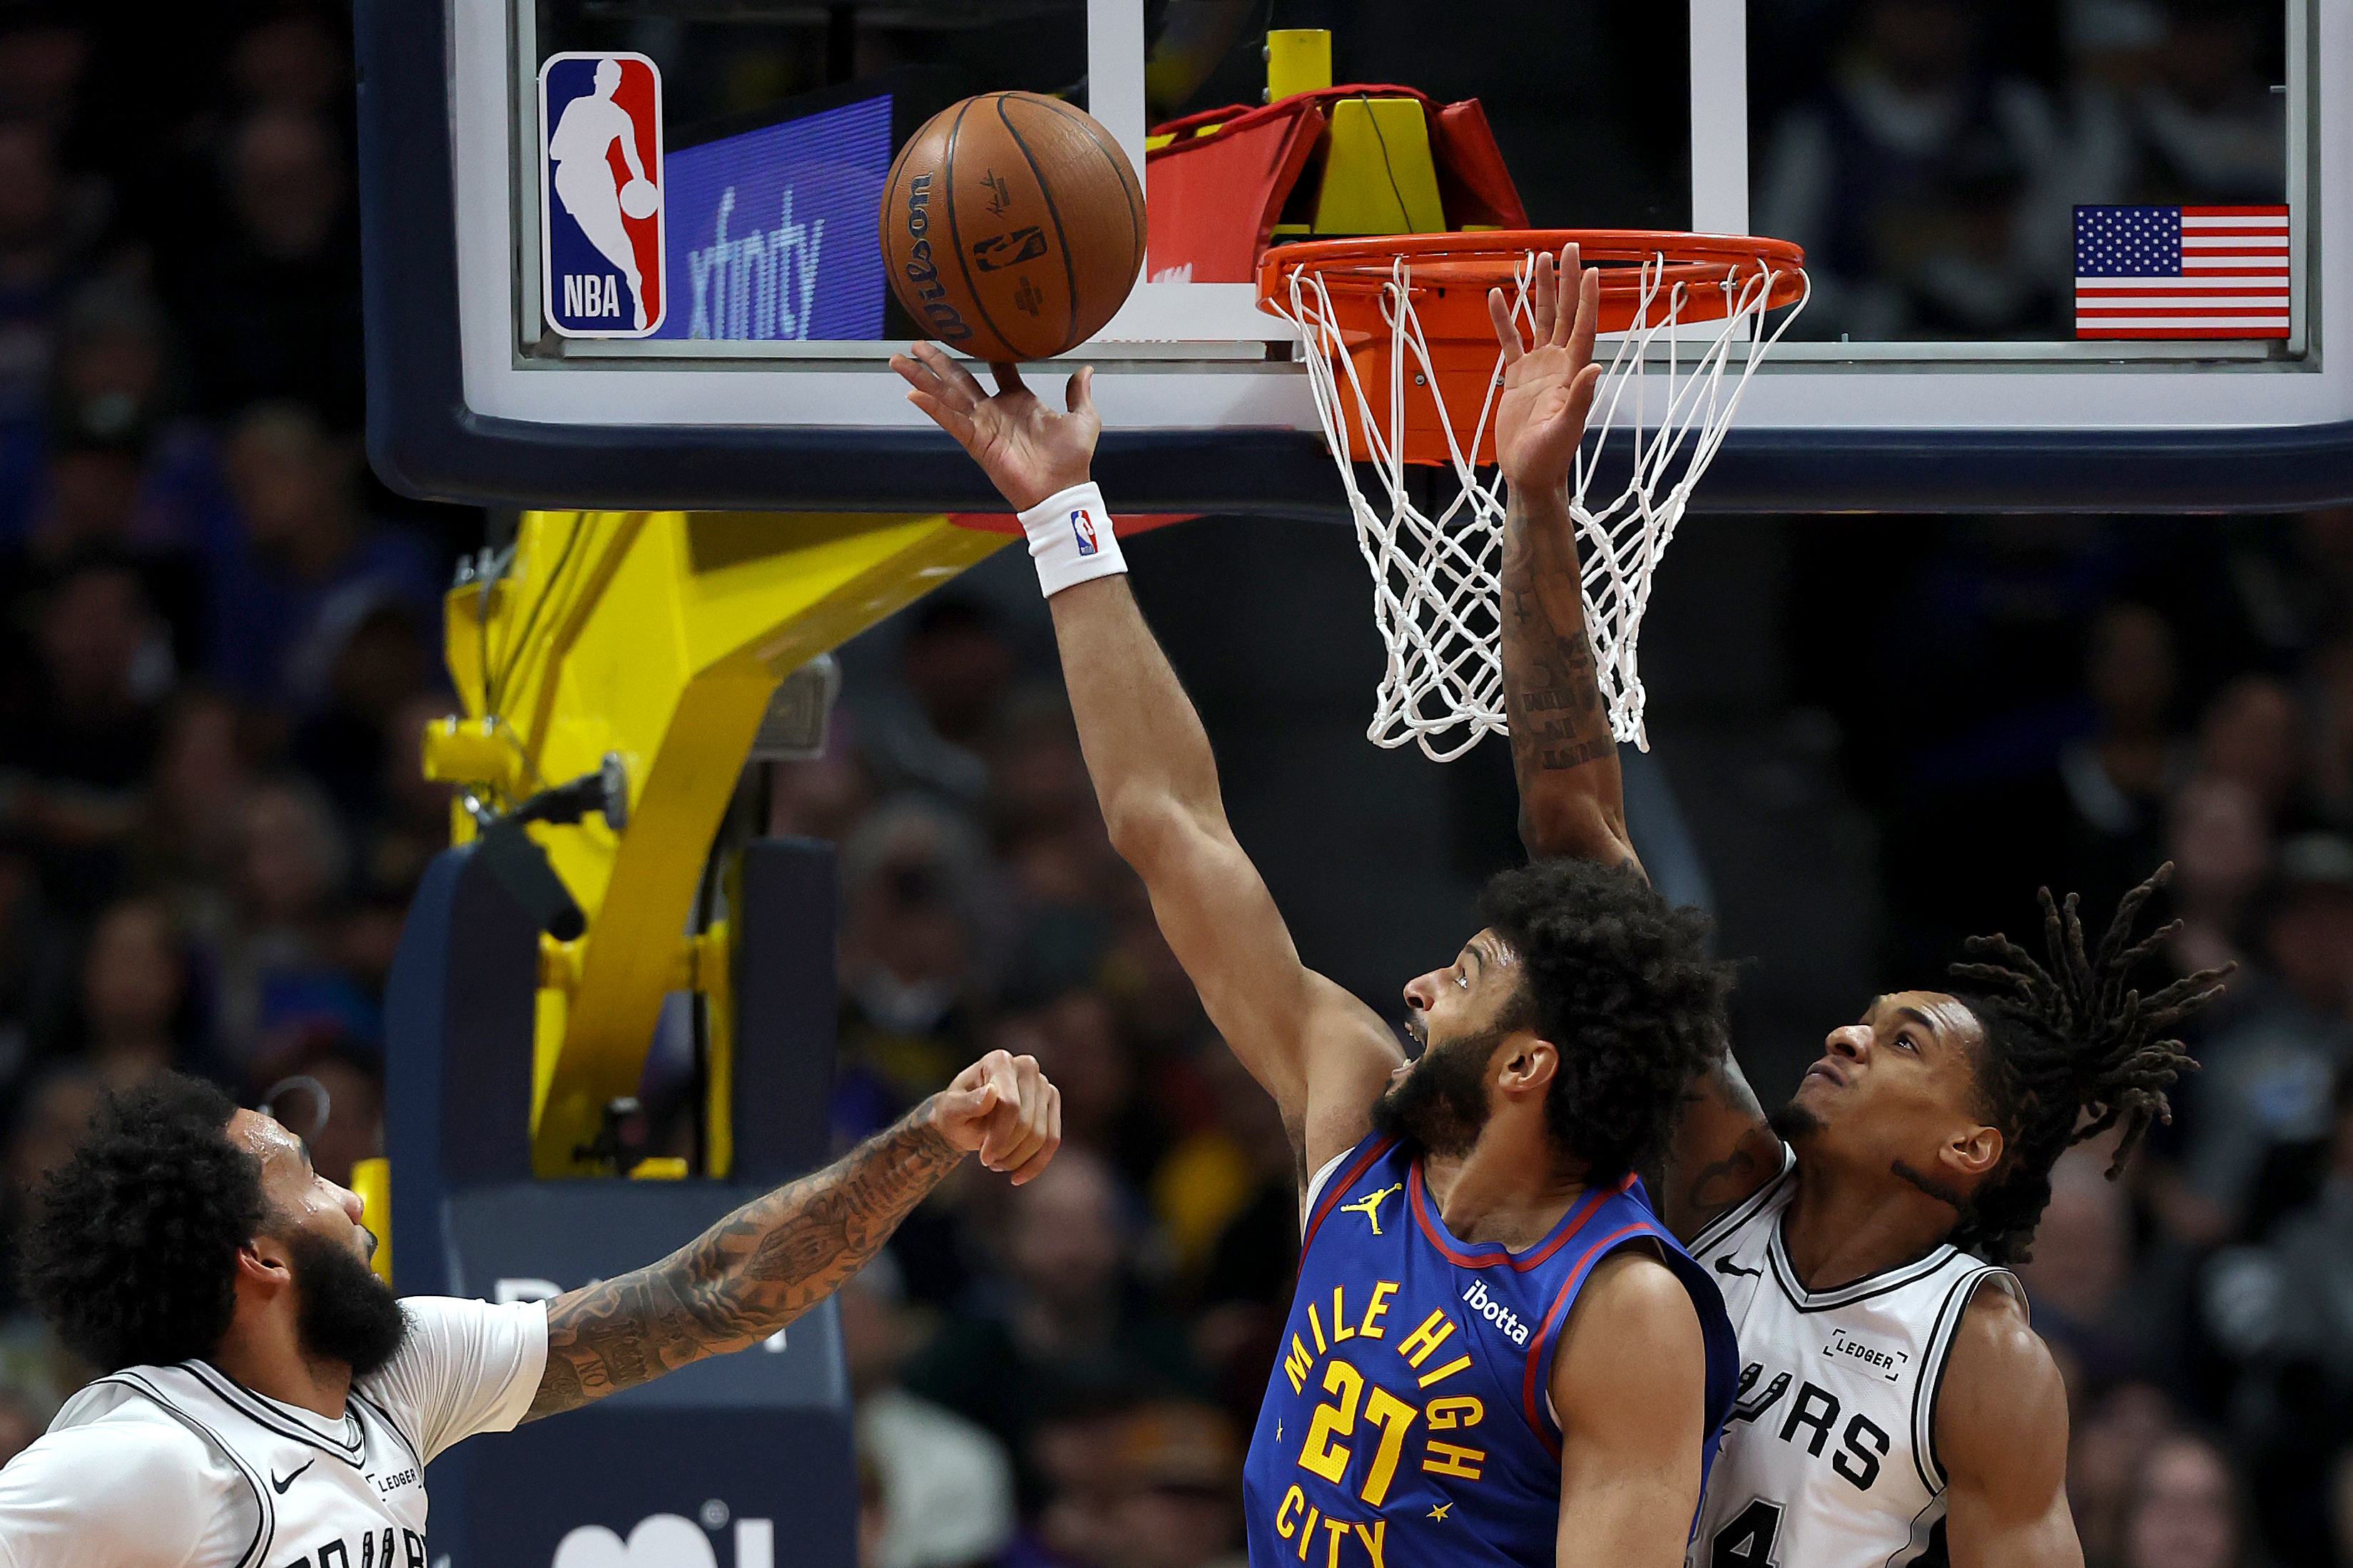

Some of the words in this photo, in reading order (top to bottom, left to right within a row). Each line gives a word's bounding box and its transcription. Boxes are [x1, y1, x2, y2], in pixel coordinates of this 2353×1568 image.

[687, 183, 825, 340] xfinity
[906, 171, 973, 340] Wilson
[563, 273, 621, 318] NBA
[1462, 1278, 1529, 1345] ibotta
[576, 1359, 607, 1387] NO
[1283, 1279, 1401, 1396] MILE
[1396, 1306, 1486, 1482] HIGH
[1835, 1338, 1894, 1370] LEDGER
[1296, 1358, 1420, 1508] 27
[1722, 1362, 1891, 1492] URS
[377, 1468, 417, 1492] LEDGER
[1274, 1482, 1386, 1568] CITY
[1684, 1495, 1787, 1568] 4
